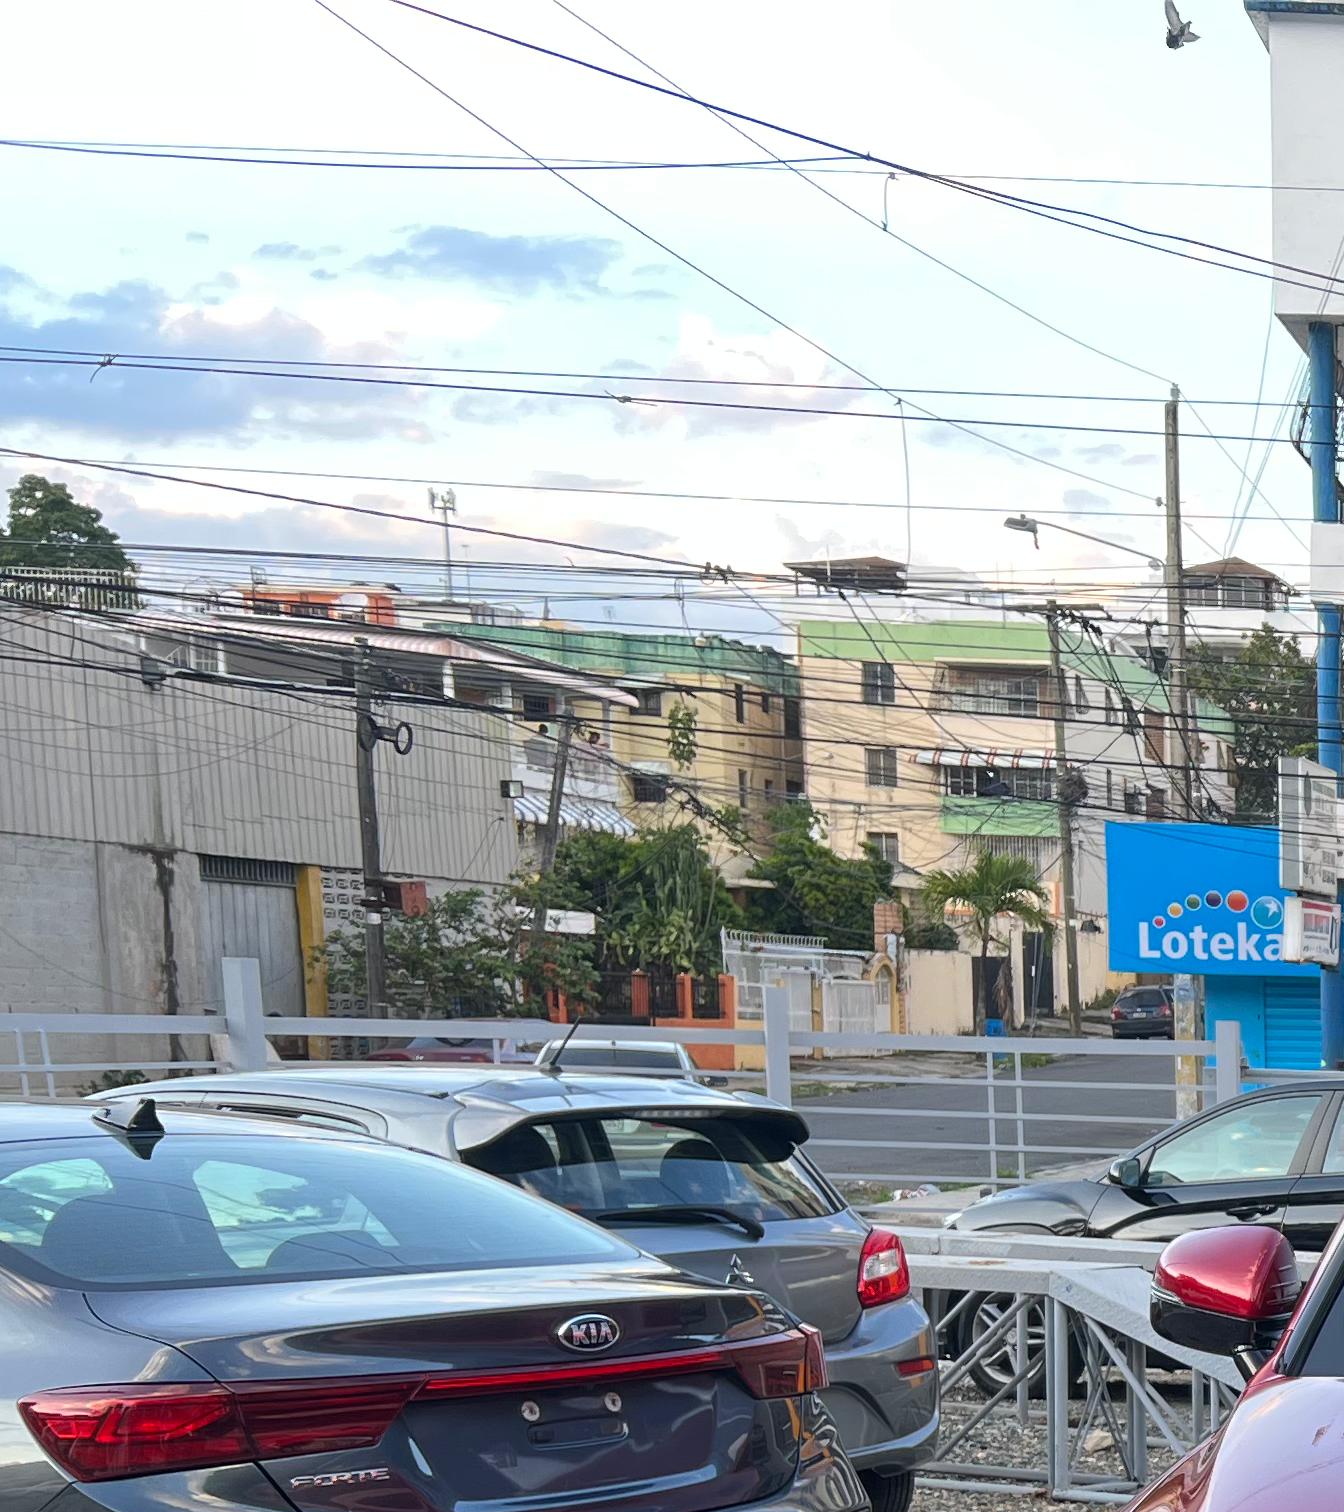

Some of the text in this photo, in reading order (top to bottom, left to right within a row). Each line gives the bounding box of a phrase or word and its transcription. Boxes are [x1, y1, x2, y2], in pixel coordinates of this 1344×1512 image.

[1138, 921, 1285, 962] Loteka
[570, 1321, 614, 1346] KIA
[290, 1467, 390, 1488] FORTE
